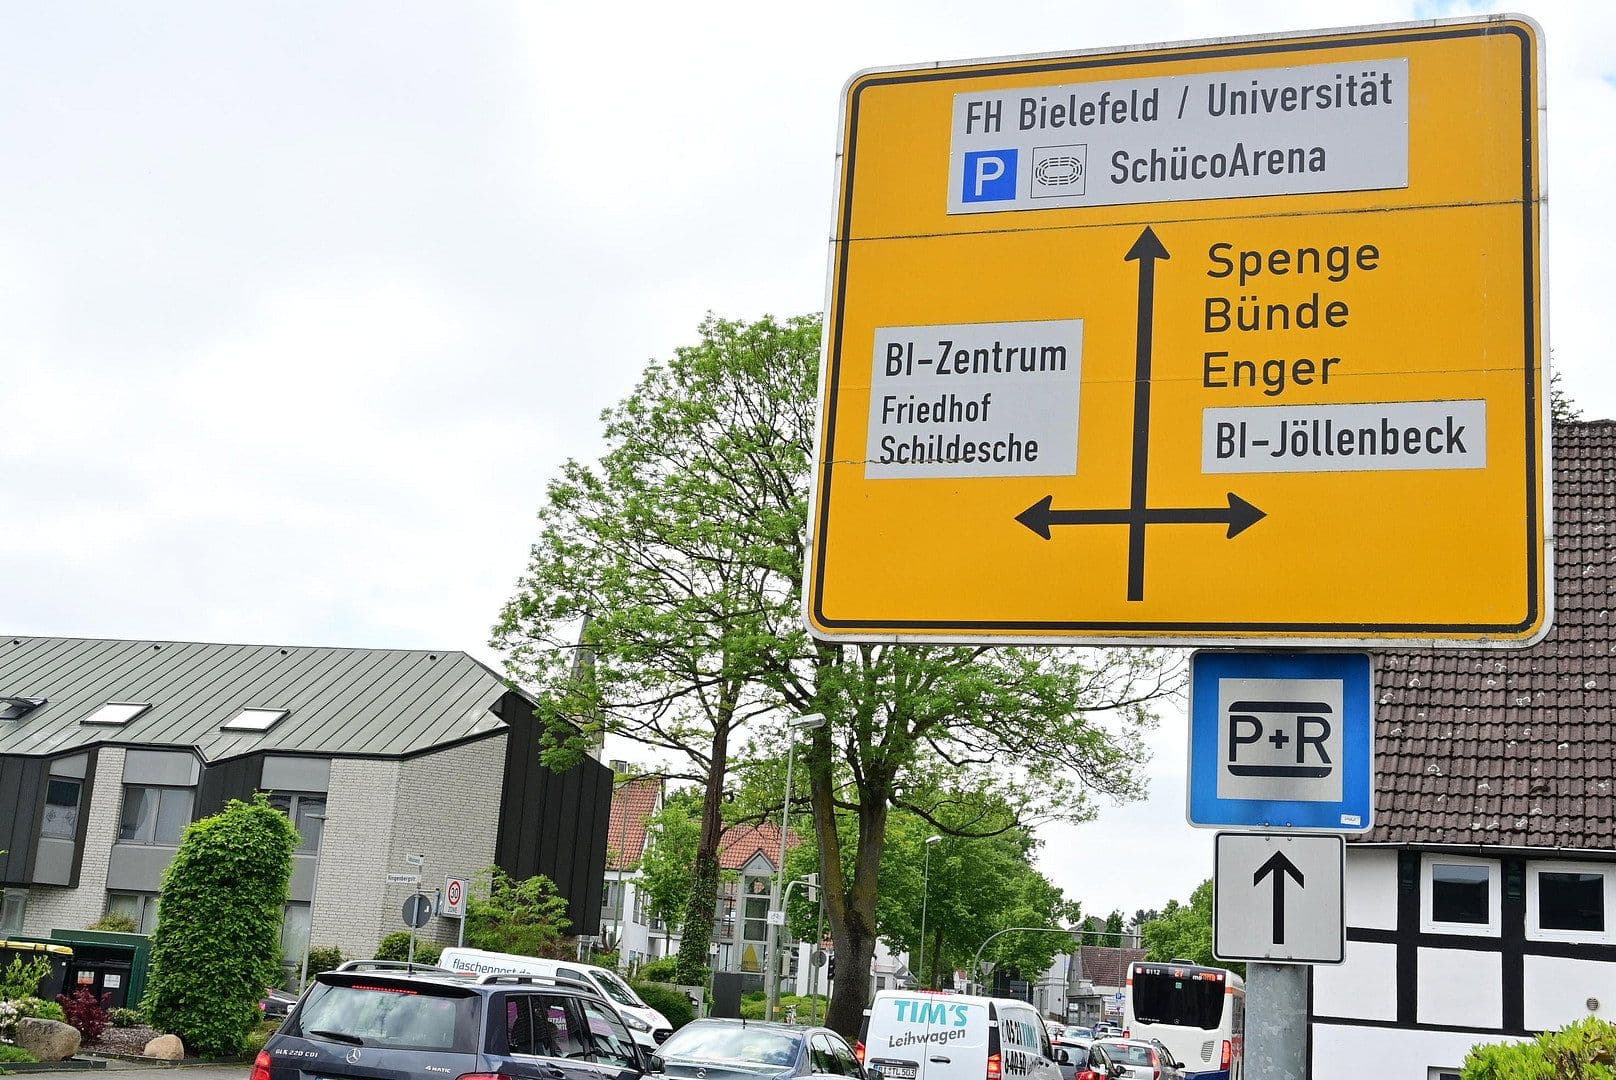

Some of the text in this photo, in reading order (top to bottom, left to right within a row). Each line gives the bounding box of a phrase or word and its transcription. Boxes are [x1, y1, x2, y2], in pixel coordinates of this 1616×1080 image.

[966, 71, 1392, 134] FH Bielefeld / Universität
[974, 156, 1005, 197] P
[1110, 142, 1327, 185] SchücoArena
[1206, 242, 1380, 287] Spenge
[1204, 292, 1349, 333] Bünde
[885, 340, 1067, 377] BI-Zentrum
[1203, 351, 1341, 396] Enger
[882, 392, 992, 424] Friedhof
[880, 432, 1039, 465] Schildesche
[1216, 415, 1467, 459] BI-Jöllenbeck
[1228, 715, 1332, 764] P+R
[451, 887, 459, 899] 30
[1174, 968, 1185, 977] 27
[894, 1000, 969, 1027] TIM'S
[889, 1029, 966, 1048] Leihwagen
